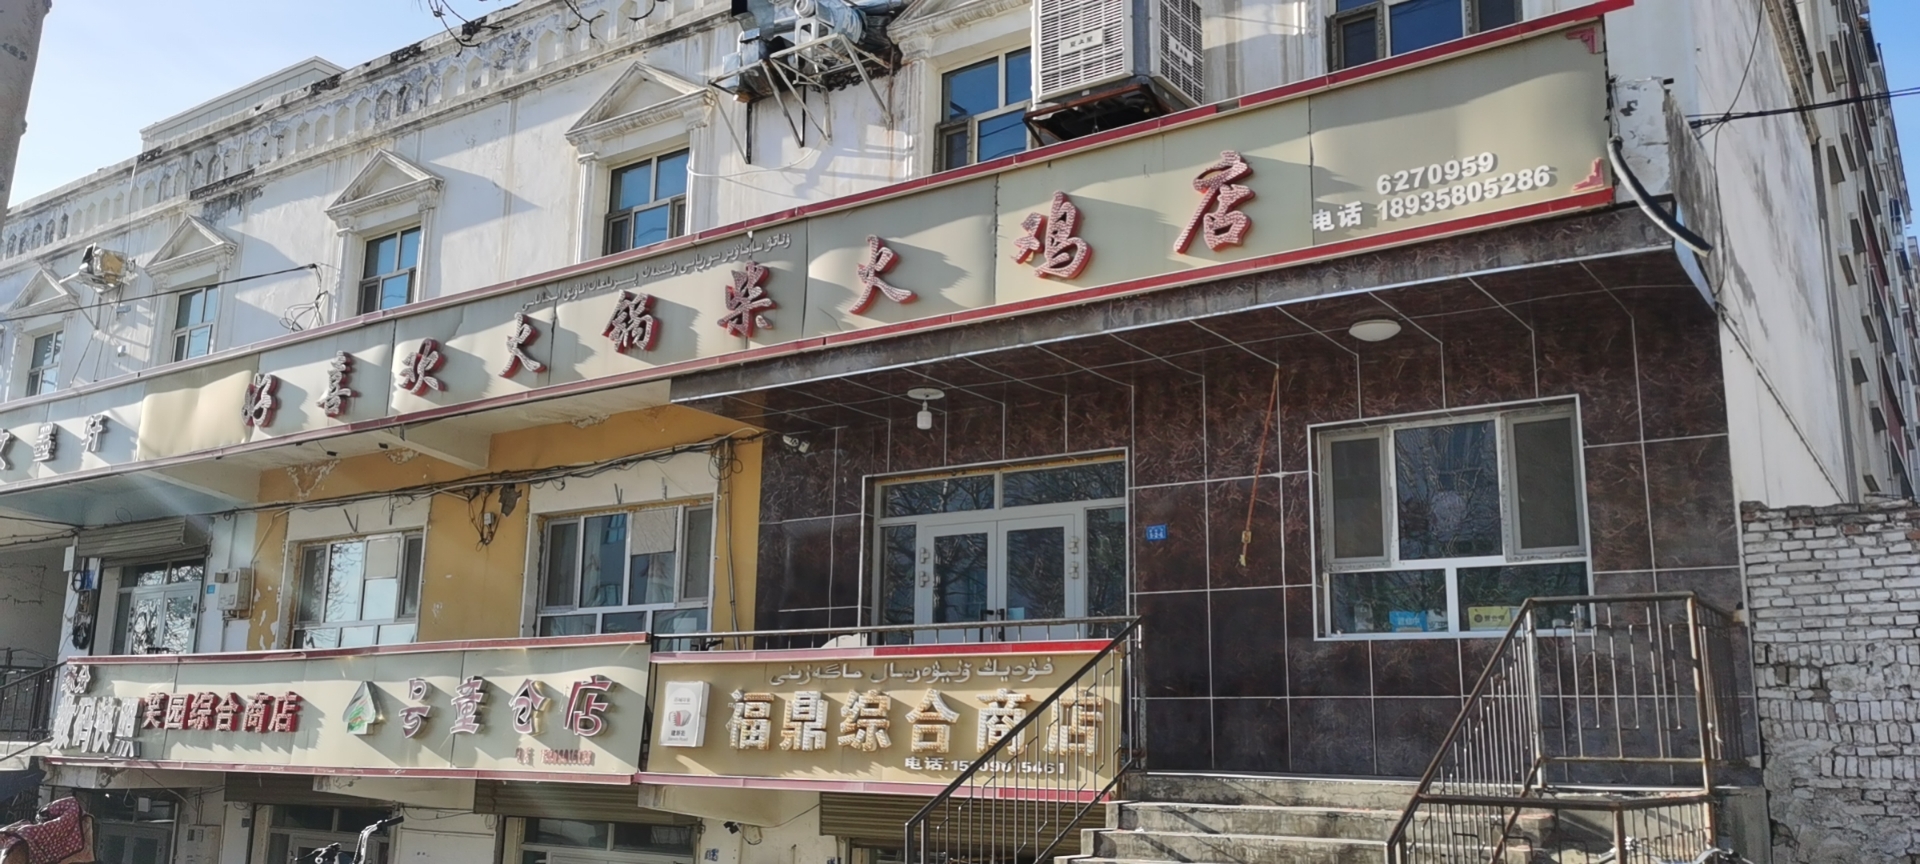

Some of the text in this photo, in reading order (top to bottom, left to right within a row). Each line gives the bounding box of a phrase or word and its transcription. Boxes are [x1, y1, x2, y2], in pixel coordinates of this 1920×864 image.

[1312, 164, 1552, 232] 电话 18935805286
[1376, 151, 1495, 196] 6270959
[241, 150, 1256, 429] 好喜欢火锅柴火鸡店
[727, 687, 1105, 757] 福鼎综合商店
